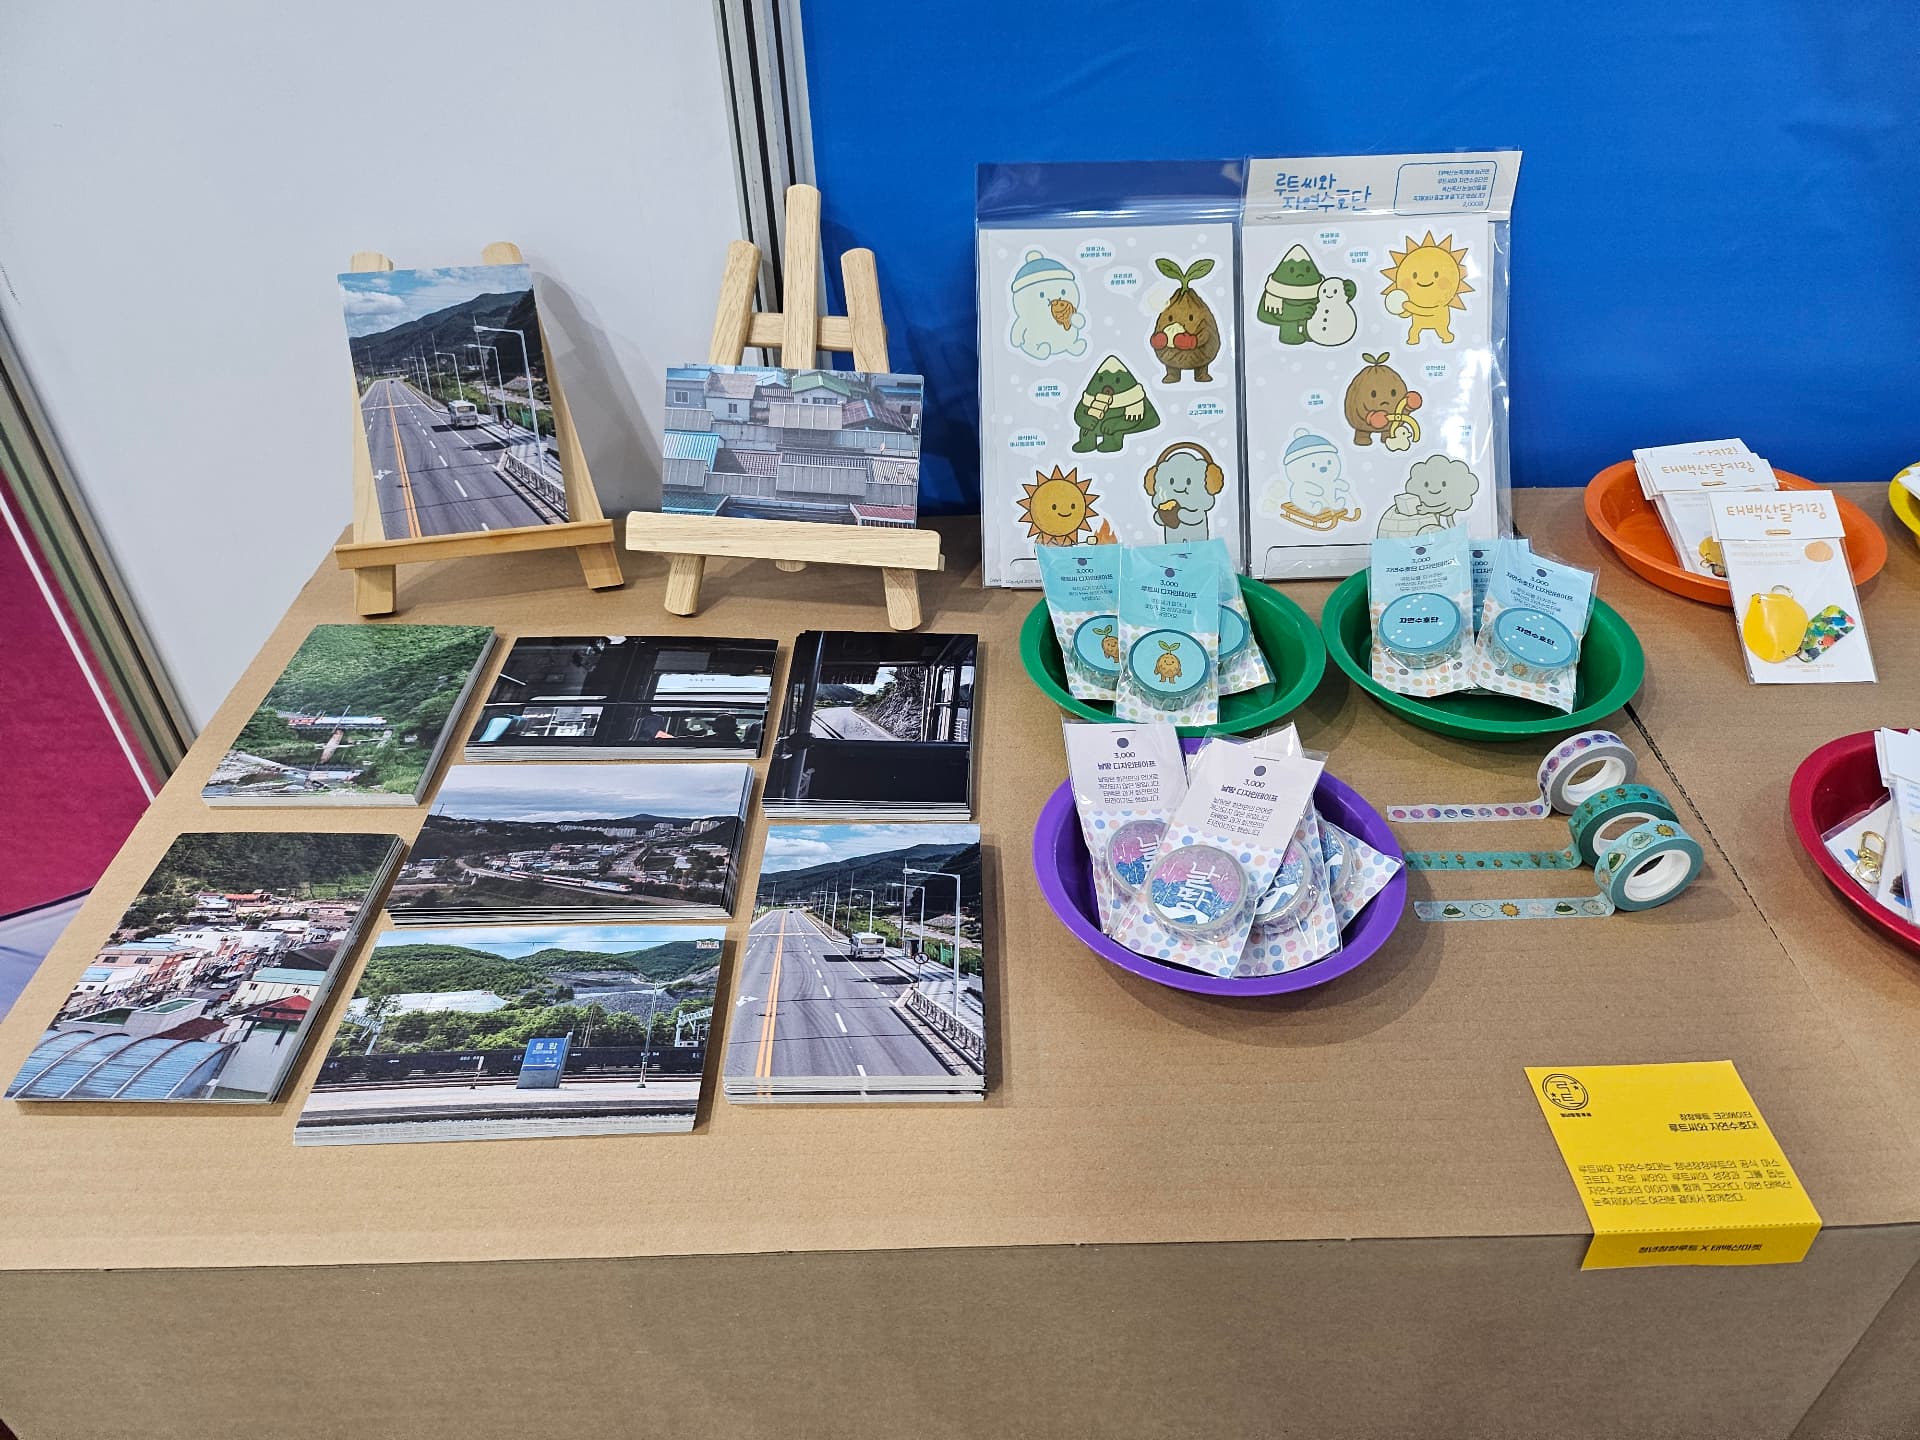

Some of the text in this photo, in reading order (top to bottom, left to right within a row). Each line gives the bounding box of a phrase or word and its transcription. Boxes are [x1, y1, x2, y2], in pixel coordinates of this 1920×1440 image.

[1274, 173, 1337, 196] 루트씨와
[1661, 461, 1755, 477] 태백산달키링
[1726, 502, 1827, 523] 태백산달키링
[1160, 579, 1179, 588] 3,000
[1160, 588, 1198, 599] 디자인테이프
[1399, 616, 1439, 624] 자연수호단
[1515, 625, 1555, 646] 자연수호단
[1113, 751, 1136, 760] 3,000
[1113, 760, 1158, 770] 디자인테이프
[1243, 779, 1266, 788] 3,000
[1236, 788, 1279, 802] 디자인테이프
[1668, 1120, 1759, 1133] 루트씨와 자연수호대
[1578, 1164, 1615, 1174] 루트씨와
[1643, 1184, 1681, 1194] 이야기를
